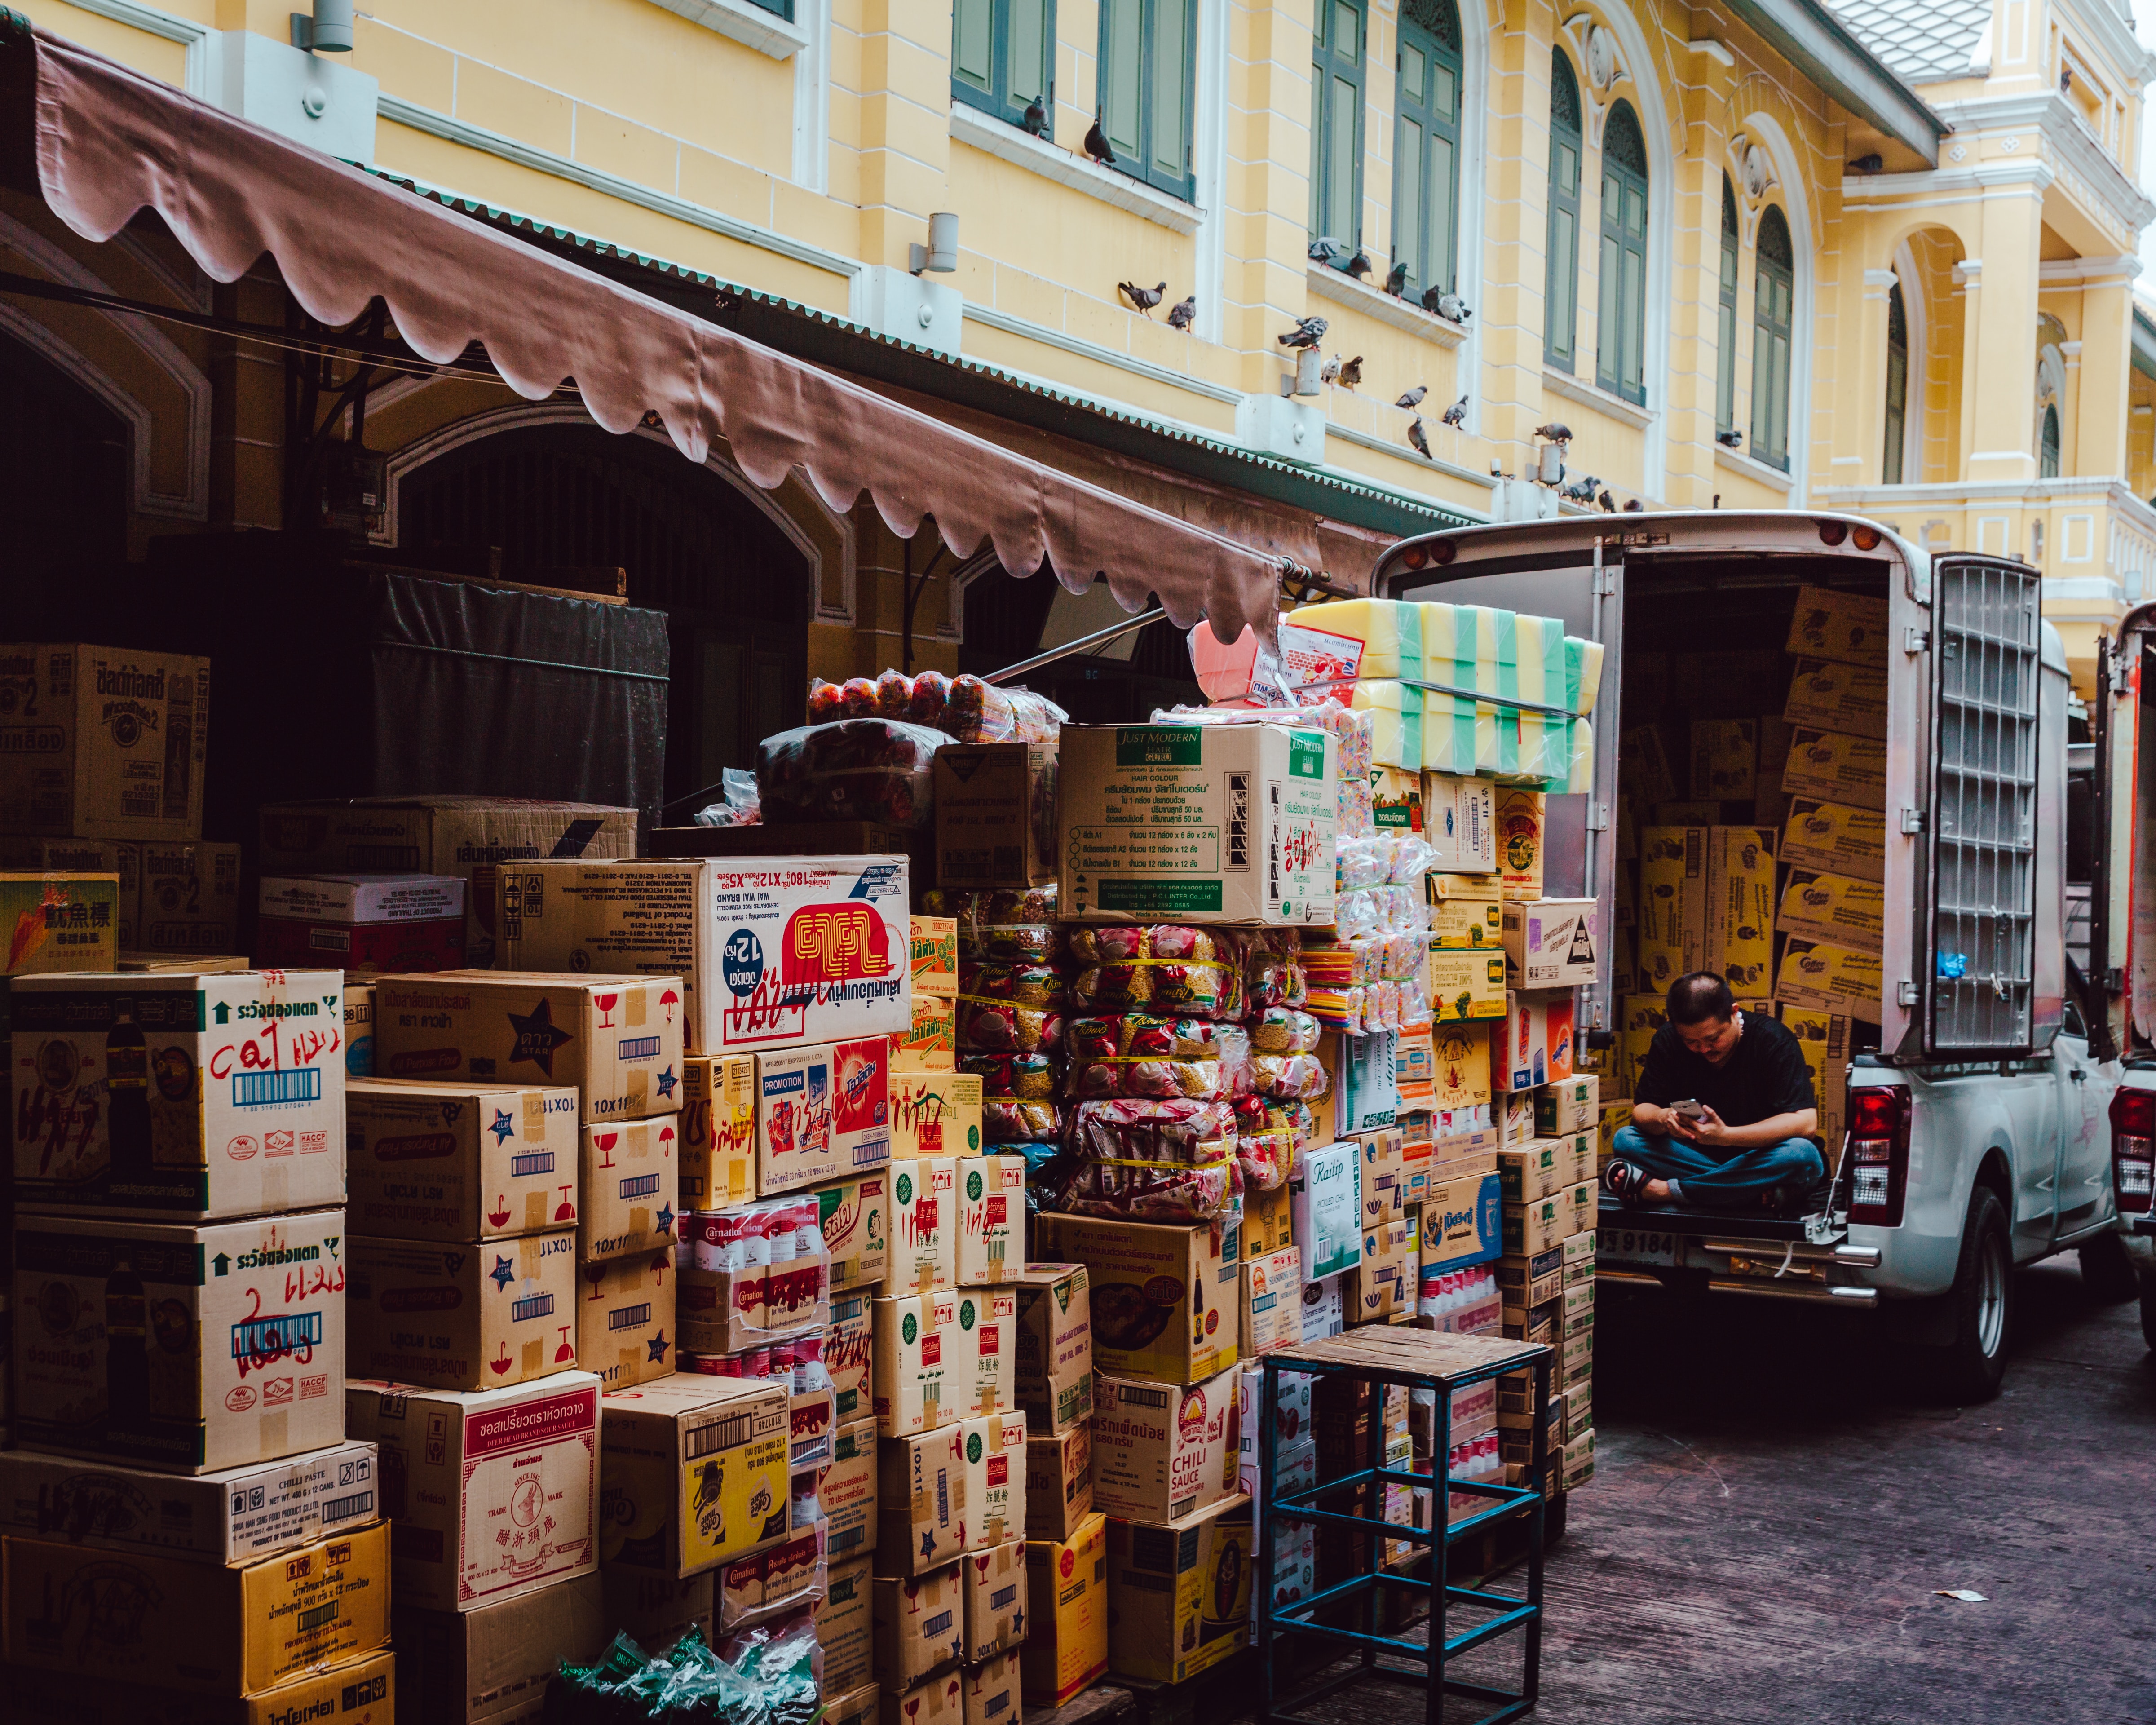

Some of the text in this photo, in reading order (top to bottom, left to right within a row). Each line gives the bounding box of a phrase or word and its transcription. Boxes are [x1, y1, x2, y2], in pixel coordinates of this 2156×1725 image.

[24, 677, 38, 717] 2
[1148, 733, 1197, 743] MODERN
[1290, 735, 1324, 753] JUST MODERN
[1303, 755, 1314, 764] HAIR
[1300, 790, 1322, 800] HAIR COLOUR
[947, 816, 964, 825] 600
[456, 838, 539, 863] เส้นหมี่อบแห้ง
[717, 873, 729, 881] Sets
[729, 871, 808, 888] 180 X12 X5
[186, 876, 200, 913] 2
[717, 893, 769, 903] WAI WAI BRAND
[1299, 886, 1305, 896] B1
[420, 907, 442, 916] PRODUCT
[932, 922, 954, 930] 100273748
[725, 937, 760, 963] 12 ห่อ
[827, 979, 901, 1008] เส้นหมี่อบแห้ง
[238, 1000, 318, 1019] ระวังของแตก
[399, 1014, 417, 1027] ตรา
[1077, 1022, 1108, 1035] ไร่ทิพย์
[522, 1047, 548, 1055] STAR
[394, 1053, 459, 1070] All Purpose Flour
[733, 1066, 750, 1075] 21134297
[764, 1075, 802, 1091] PROMOTION
[301, 1133, 326, 1142] HACCP
[377, 1137, 451, 1155] All Purpose Flour
[765, 1170, 789, 1186] น้ำหนักสุทธิ
[968, 1177, 981, 1194] QUALITY
[384, 1183, 443, 1202] ดาวฟ้า ตรา
[731, 1188, 742, 1196] Holdings
[898, 1180, 910, 1196] QUALITY
[900, 1186, 911, 1203] PRODUCT
[970, 1184, 981, 1198] PRODUCT
[1317, 1197, 1334, 1209] PICKLED
[706, 1226, 742, 1240] Carnation
[1082, 1232, 1093, 1241] เบา
[1622, 1228, 1673, 1254] 9184
[237, 1245, 319, 1270] ระวังของแตก
[407, 1290, 456, 1303] All Purpose
[738, 1290, 763, 1305] Carnation
[777, 1305, 786, 1314] Weight
[1303, 1319, 1313, 1329] BROWN
[301, 1377, 326, 1388] HACCP
[480, 1402, 584, 1438] ซอสเปรี้ยวตราหัวกวาง
[758, 1415, 782, 1431] 8101749
[487, 1421, 576, 1448] DEER HEAD BRAND SOUR SAUCE
[1096, 1433, 1113, 1444] 680
[776, 1439, 782, 1447] 12
[757, 1458, 765, 1467] 900
[1172, 1448, 1206, 1473] CHILI
[278, 1470, 326, 1490] CHILLI PASTE
[513, 1472, 541, 1487] SINCE 1947
[1171, 1469, 1199, 1491] SAUCE
[270, 1486, 318, 1506] NET 12
[547, 1491, 564, 1503] MARK
[751, 1492, 772, 1513] Coffee
[827, 1496, 834, 1506] 70
[487, 1505, 508, 1519] TRADE
[700, 1513, 721, 1533] Coffee
[252, 1535, 273, 1548] PRODUCT
[280, 1526, 303, 1539] THAILAND
[730, 1567, 756, 1585] Carnation
[303, 1595, 316, 1607] 900
[284, 1619, 352, 1650] PRODUCT OF THAILAND
